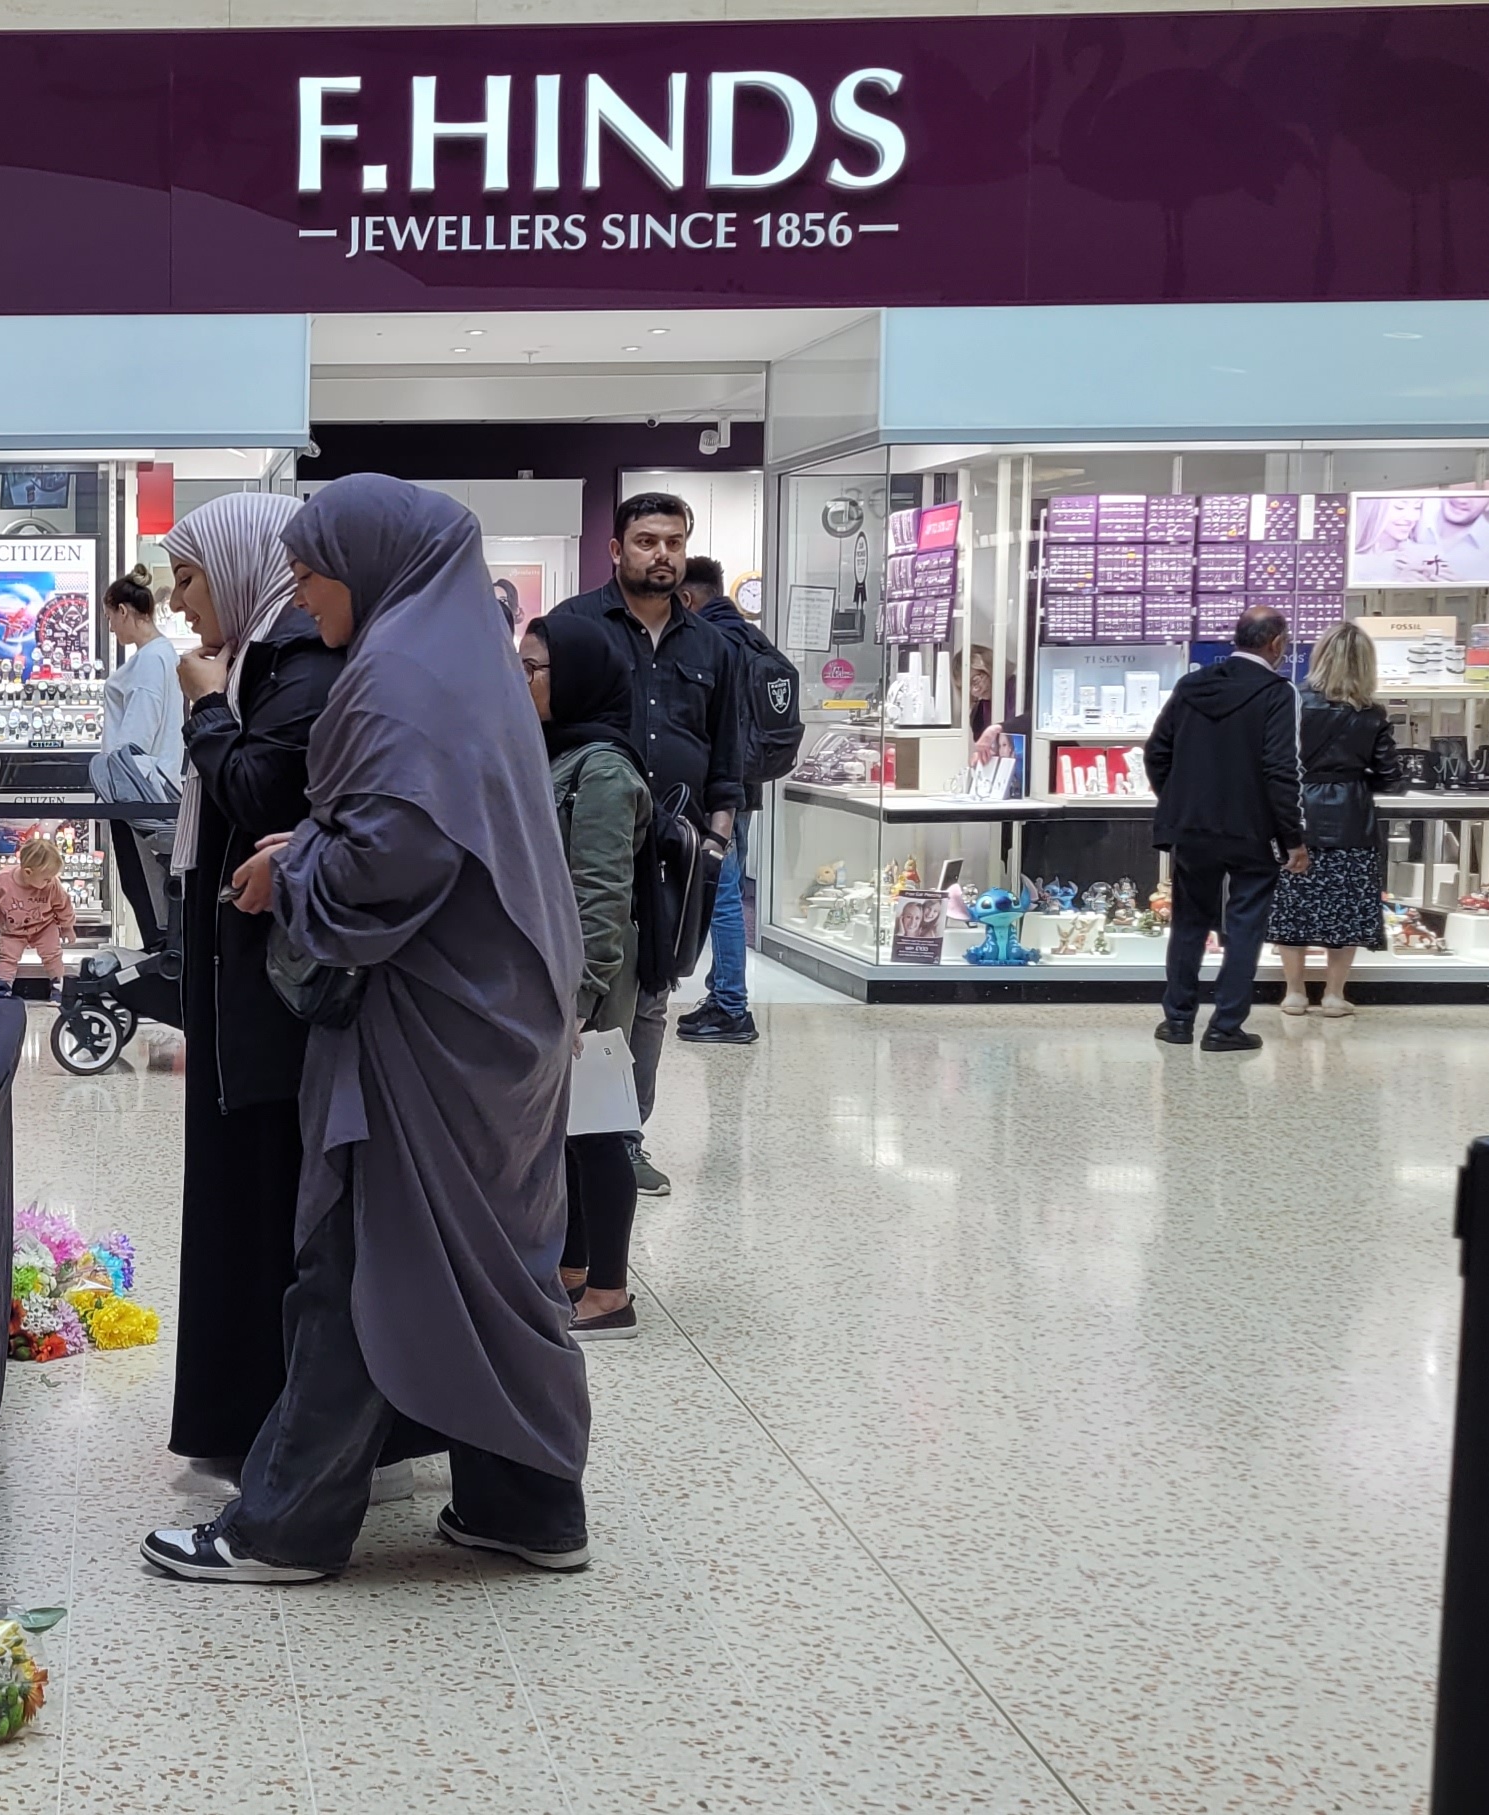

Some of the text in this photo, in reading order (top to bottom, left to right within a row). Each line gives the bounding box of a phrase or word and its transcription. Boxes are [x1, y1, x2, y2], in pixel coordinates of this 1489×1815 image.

[297, 67, 907, 194] F.HINDS
[346, 211, 854, 258] JEWELLERS SINCE 1856
[1083, 655, 1136, 664] TI SENTO
